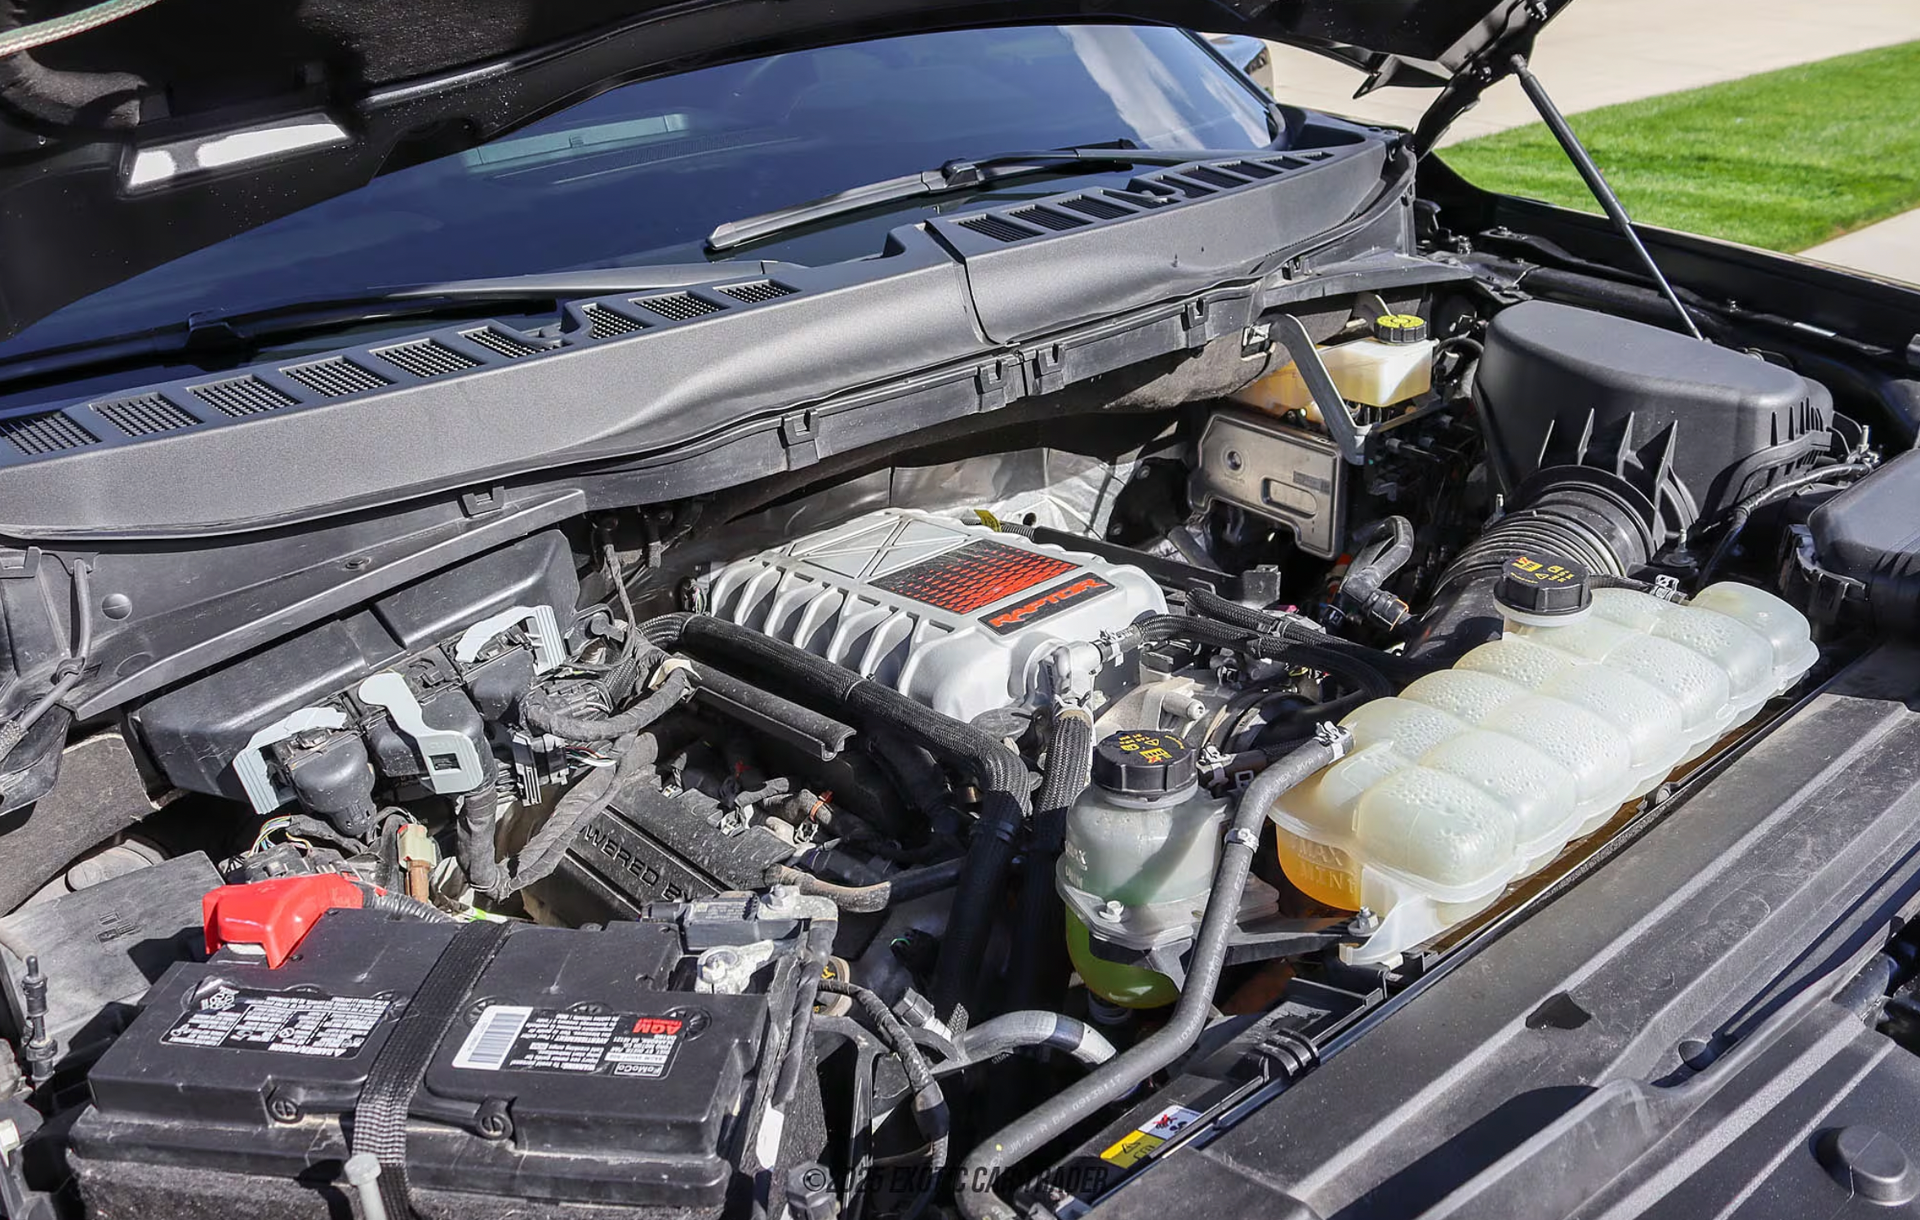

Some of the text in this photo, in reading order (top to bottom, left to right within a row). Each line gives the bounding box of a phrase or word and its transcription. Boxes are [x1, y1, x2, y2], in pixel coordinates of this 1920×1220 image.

[988, 578, 1108, 628] RAPTOR
[580, 823, 659, 887] WERED
[633, 1024, 681, 1035] AGM
[616, 1064, 661, 1073] FoMoCo
